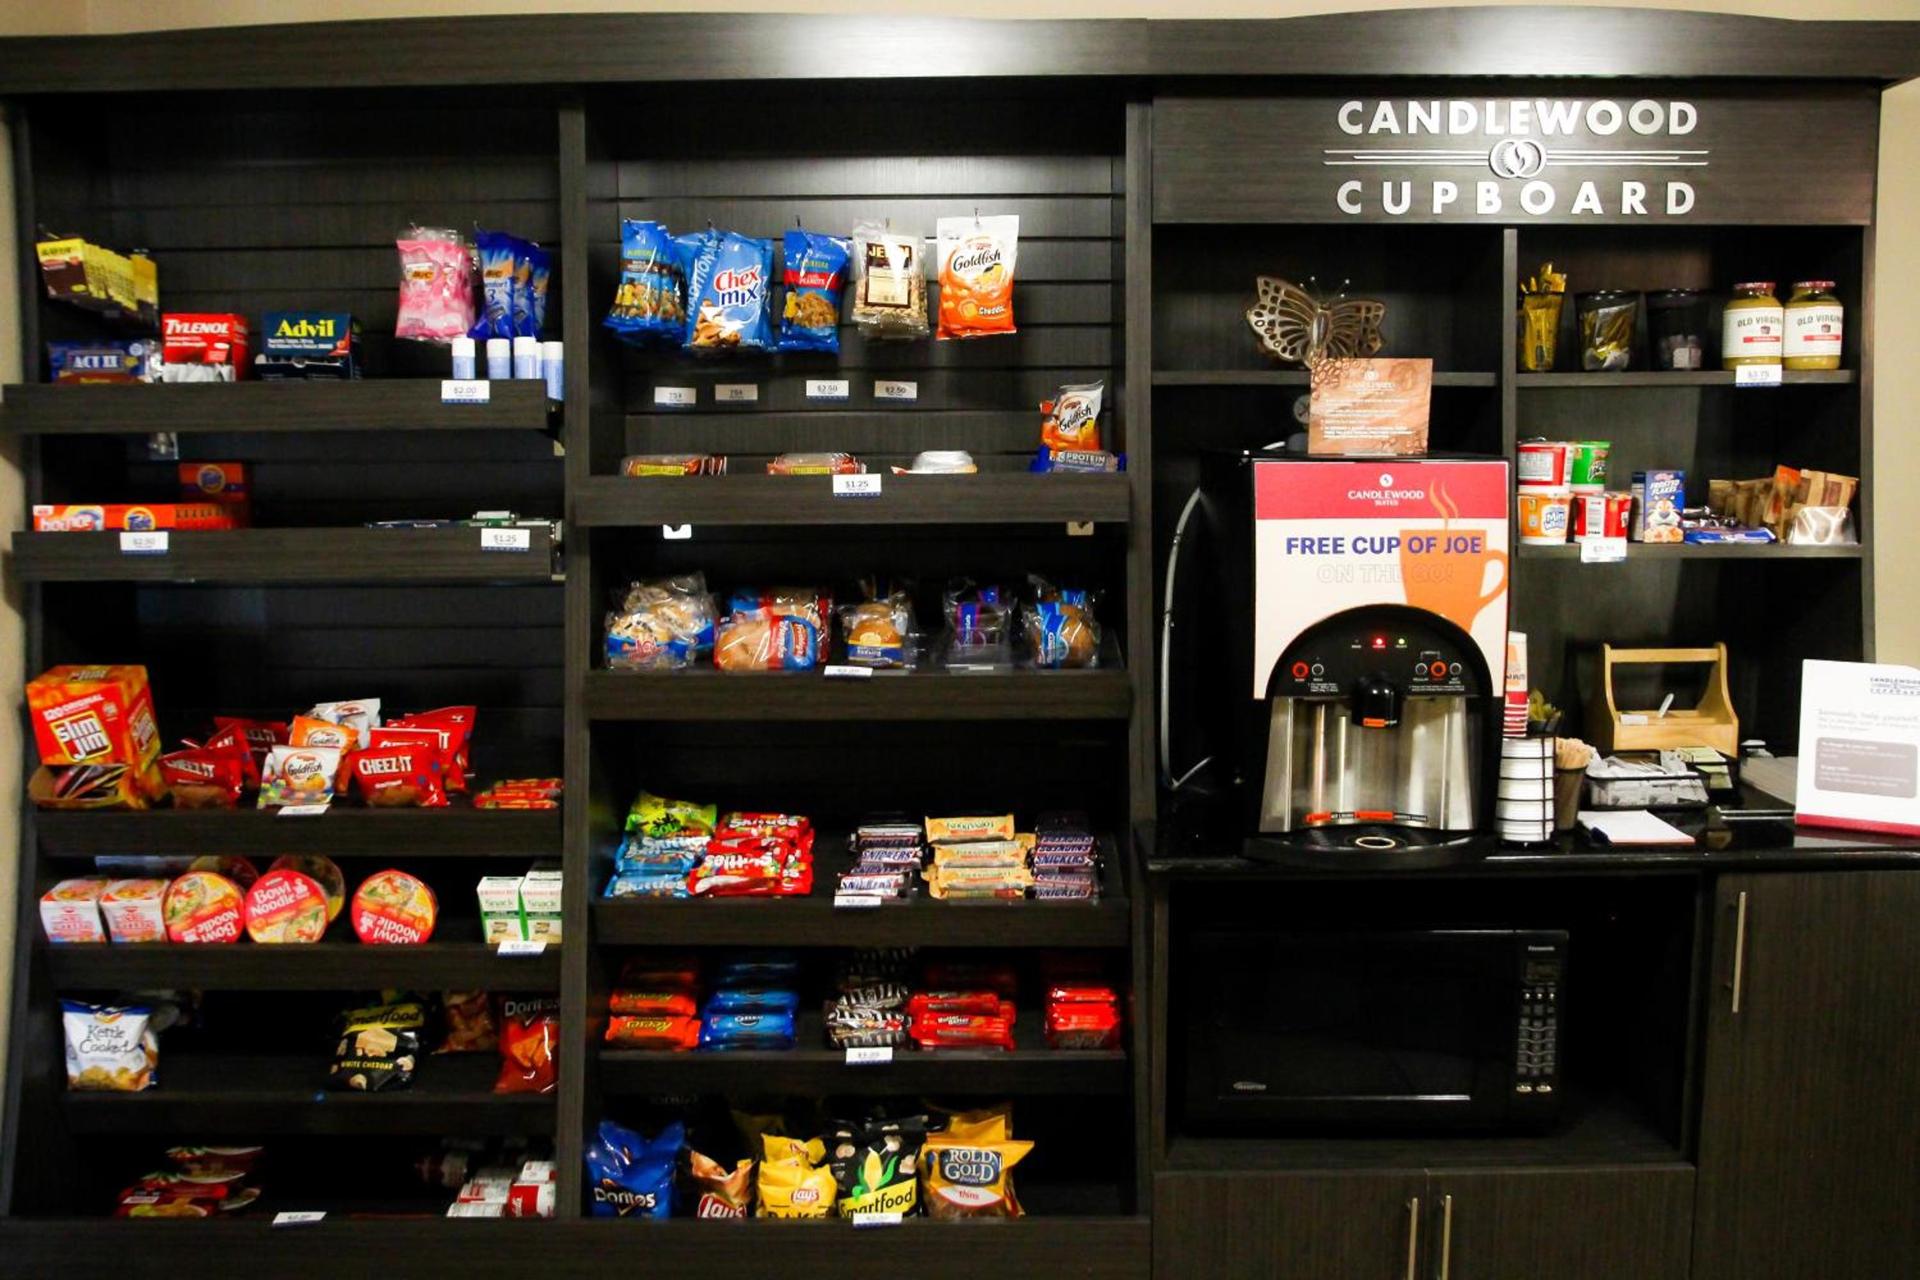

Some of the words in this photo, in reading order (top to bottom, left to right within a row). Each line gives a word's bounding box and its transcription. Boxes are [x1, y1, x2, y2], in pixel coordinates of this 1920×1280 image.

[1336, 99, 1699, 136] CANDLEWOOD
[1335, 180, 1697, 216] CUPBOARD
[953, 248, 1001, 272] Goldfish
[714, 265, 762, 293] Chex
[164, 318, 230, 334] TYLENOL
[275, 319, 336, 338] Advil
[73, 355, 99, 369] ACT
[1066, 452, 1106, 466] PROTEIN
[845, 481, 869, 489] $1.25
[1347, 490, 1425, 500] CANDLEWOOD
[1286, 537, 1345, 555] FREE
[1351, 536, 1401, 555] CUP
[1407, 535, 1437, 554] OF
[1443, 536, 1482, 554] JOE
[1316, 563, 1354, 584] ON
[286, 762, 323, 776] Goldfish
[358, 758, 399, 776] CHEEZ
[399, 755, 413, 772] IT
[862, 849, 913, 860] SNICKERS
[253, 881, 292, 902] Bowl
[250, 891, 296, 917] Noodle
[195, 904, 240, 933] Noodle
[376, 917, 421, 942] Noodle
[87, 1024, 126, 1041] Kettle
[79, 1039, 131, 1055] Cooked
[950, 1149, 994, 1164] ROLD
[944, 1163, 995, 1182] GOLD
[594, 1186, 656, 1208] Doritos
[840, 1187, 914, 1217] Smartfood
